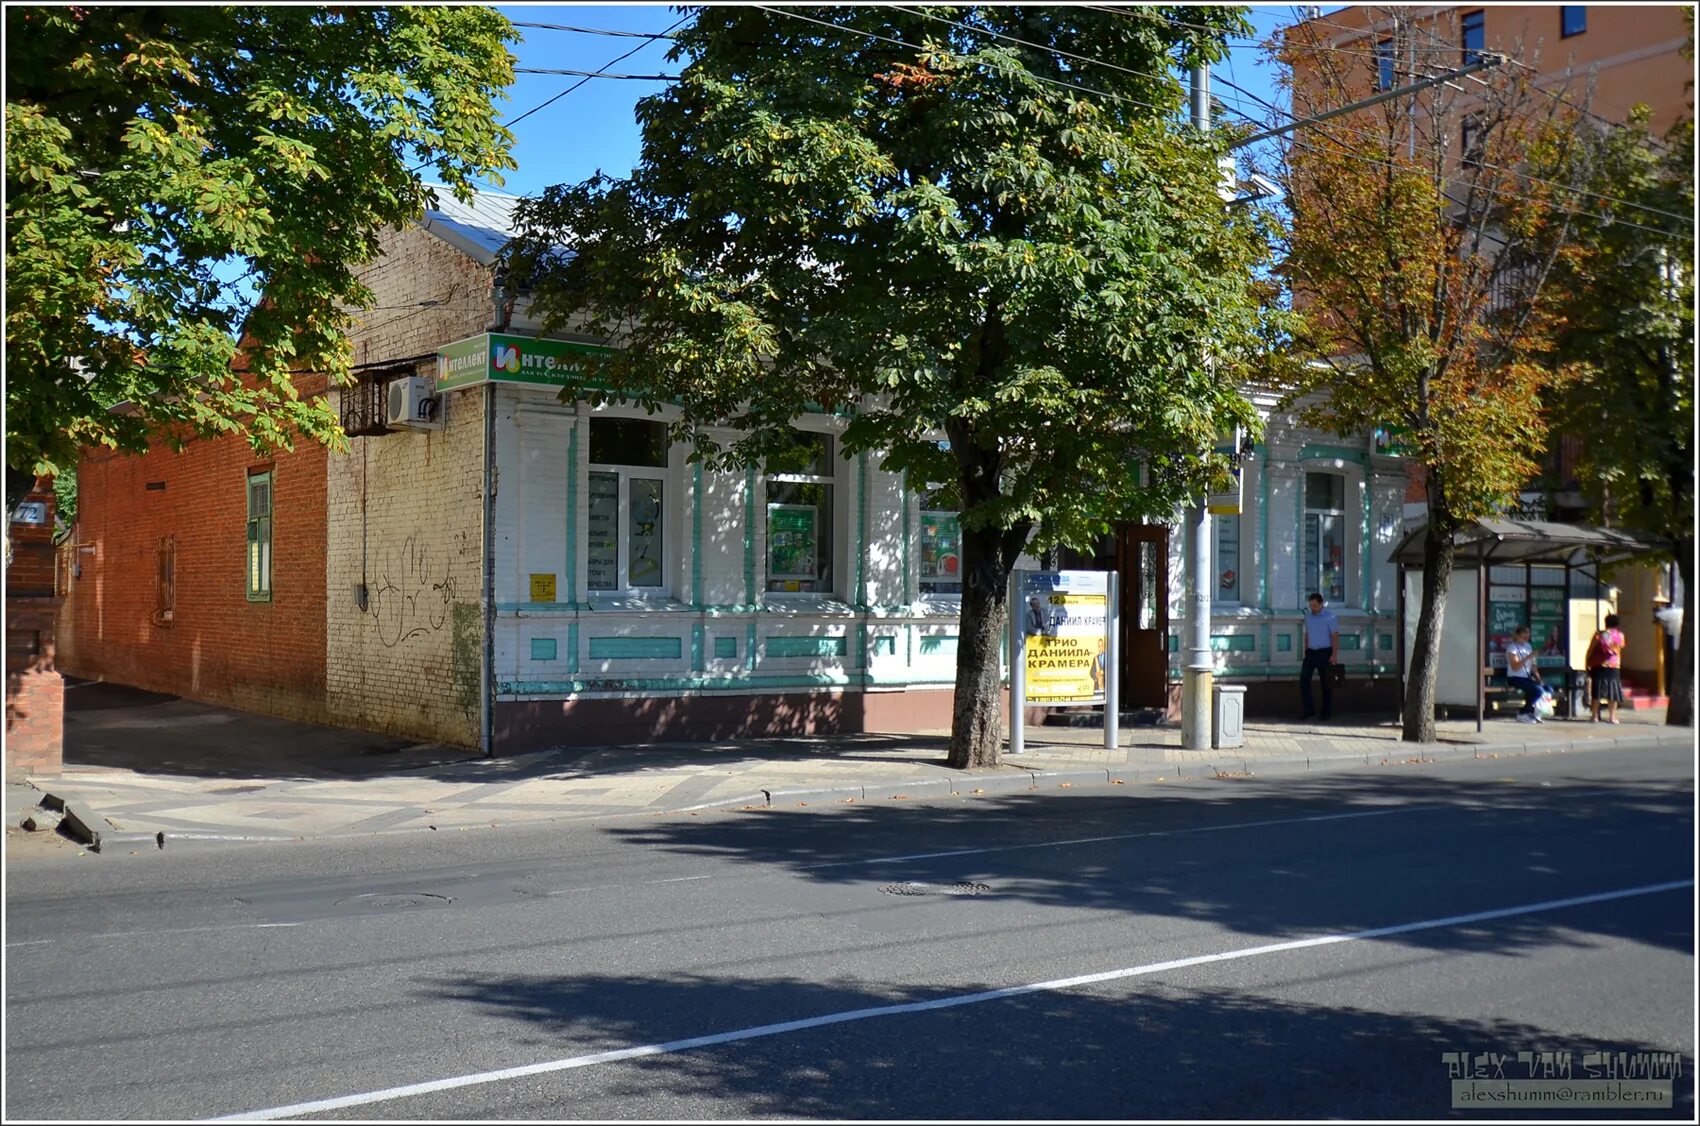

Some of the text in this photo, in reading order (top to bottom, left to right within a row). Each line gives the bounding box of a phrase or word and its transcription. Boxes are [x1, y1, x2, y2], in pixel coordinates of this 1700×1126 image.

[19, 506, 38, 520] 72
[1049, 596, 1060, 604] 12
[1049, 616, 1082, 627] ДАНИИЛ
[1046, 639, 1078, 647] ТРИО
[1028, 659, 1090, 668] КРАМЕРА
